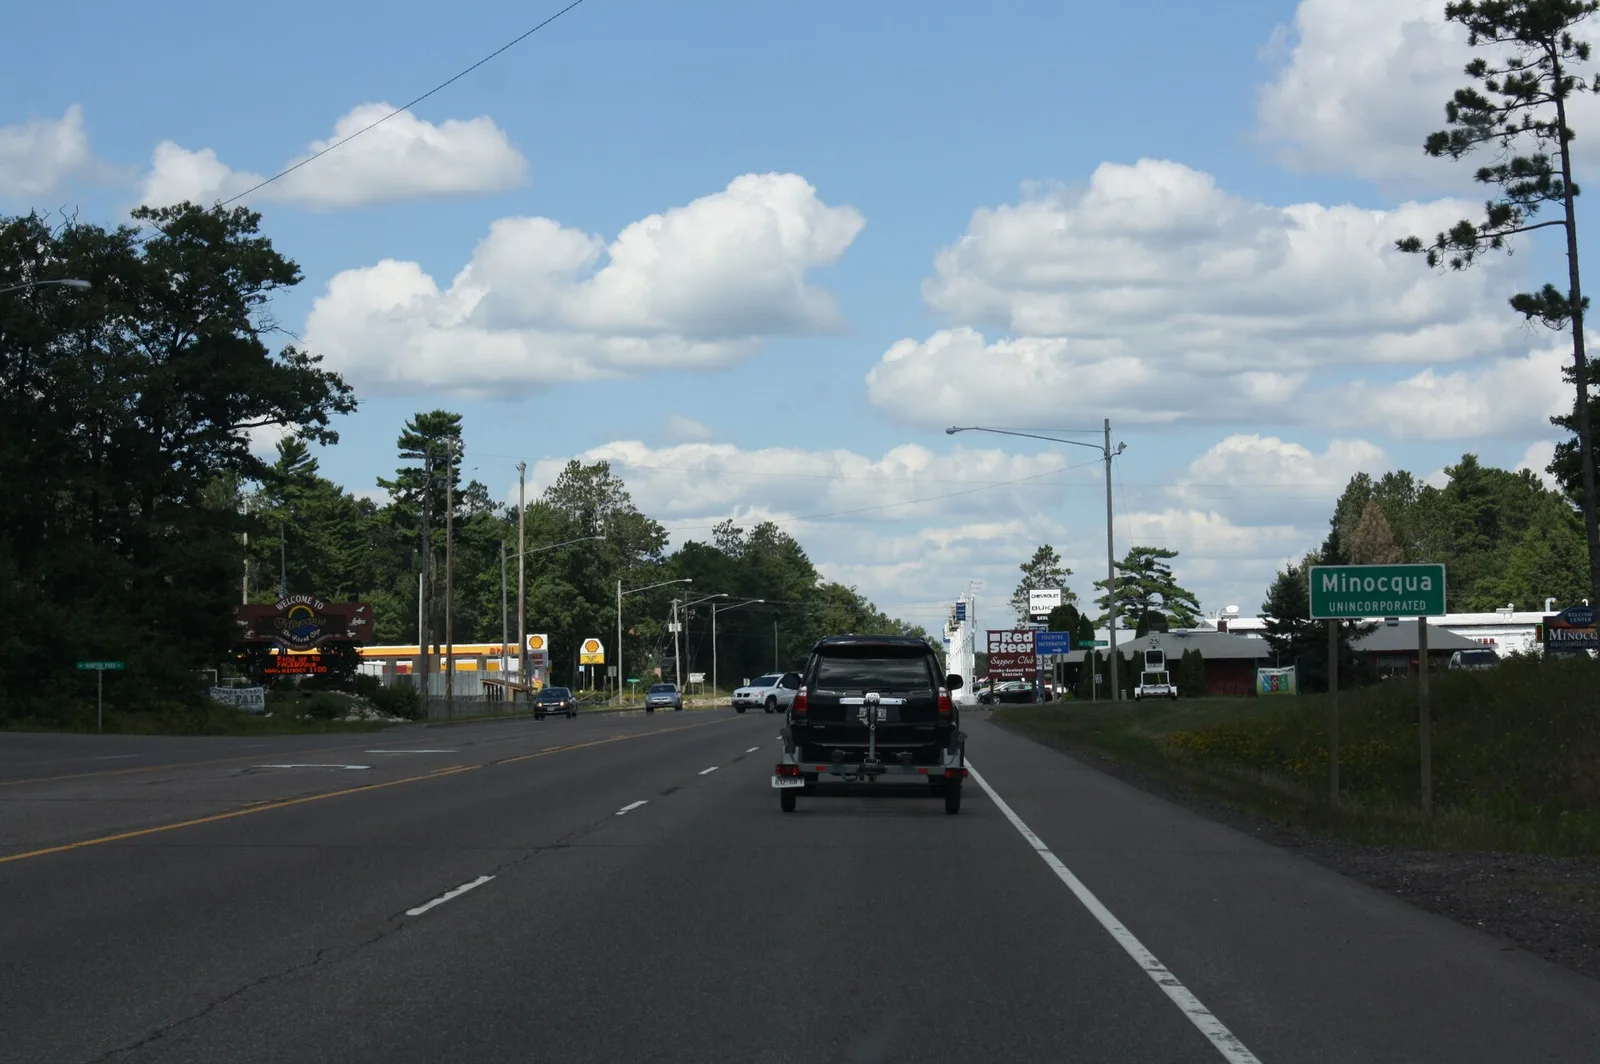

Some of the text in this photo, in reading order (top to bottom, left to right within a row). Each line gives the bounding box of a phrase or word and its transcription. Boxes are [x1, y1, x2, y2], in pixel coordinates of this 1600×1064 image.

[1323, 573, 1432, 595] Minocqua
[275, 594, 324, 611] WELCOME TO
[1329, 600, 1426, 612] UNINCORPORATED
[1001, 631, 1033, 642] Red
[989, 642, 1034, 654] Steer
[990, 656, 1015, 667] Supper
[1017, 655, 1035, 665] Club
